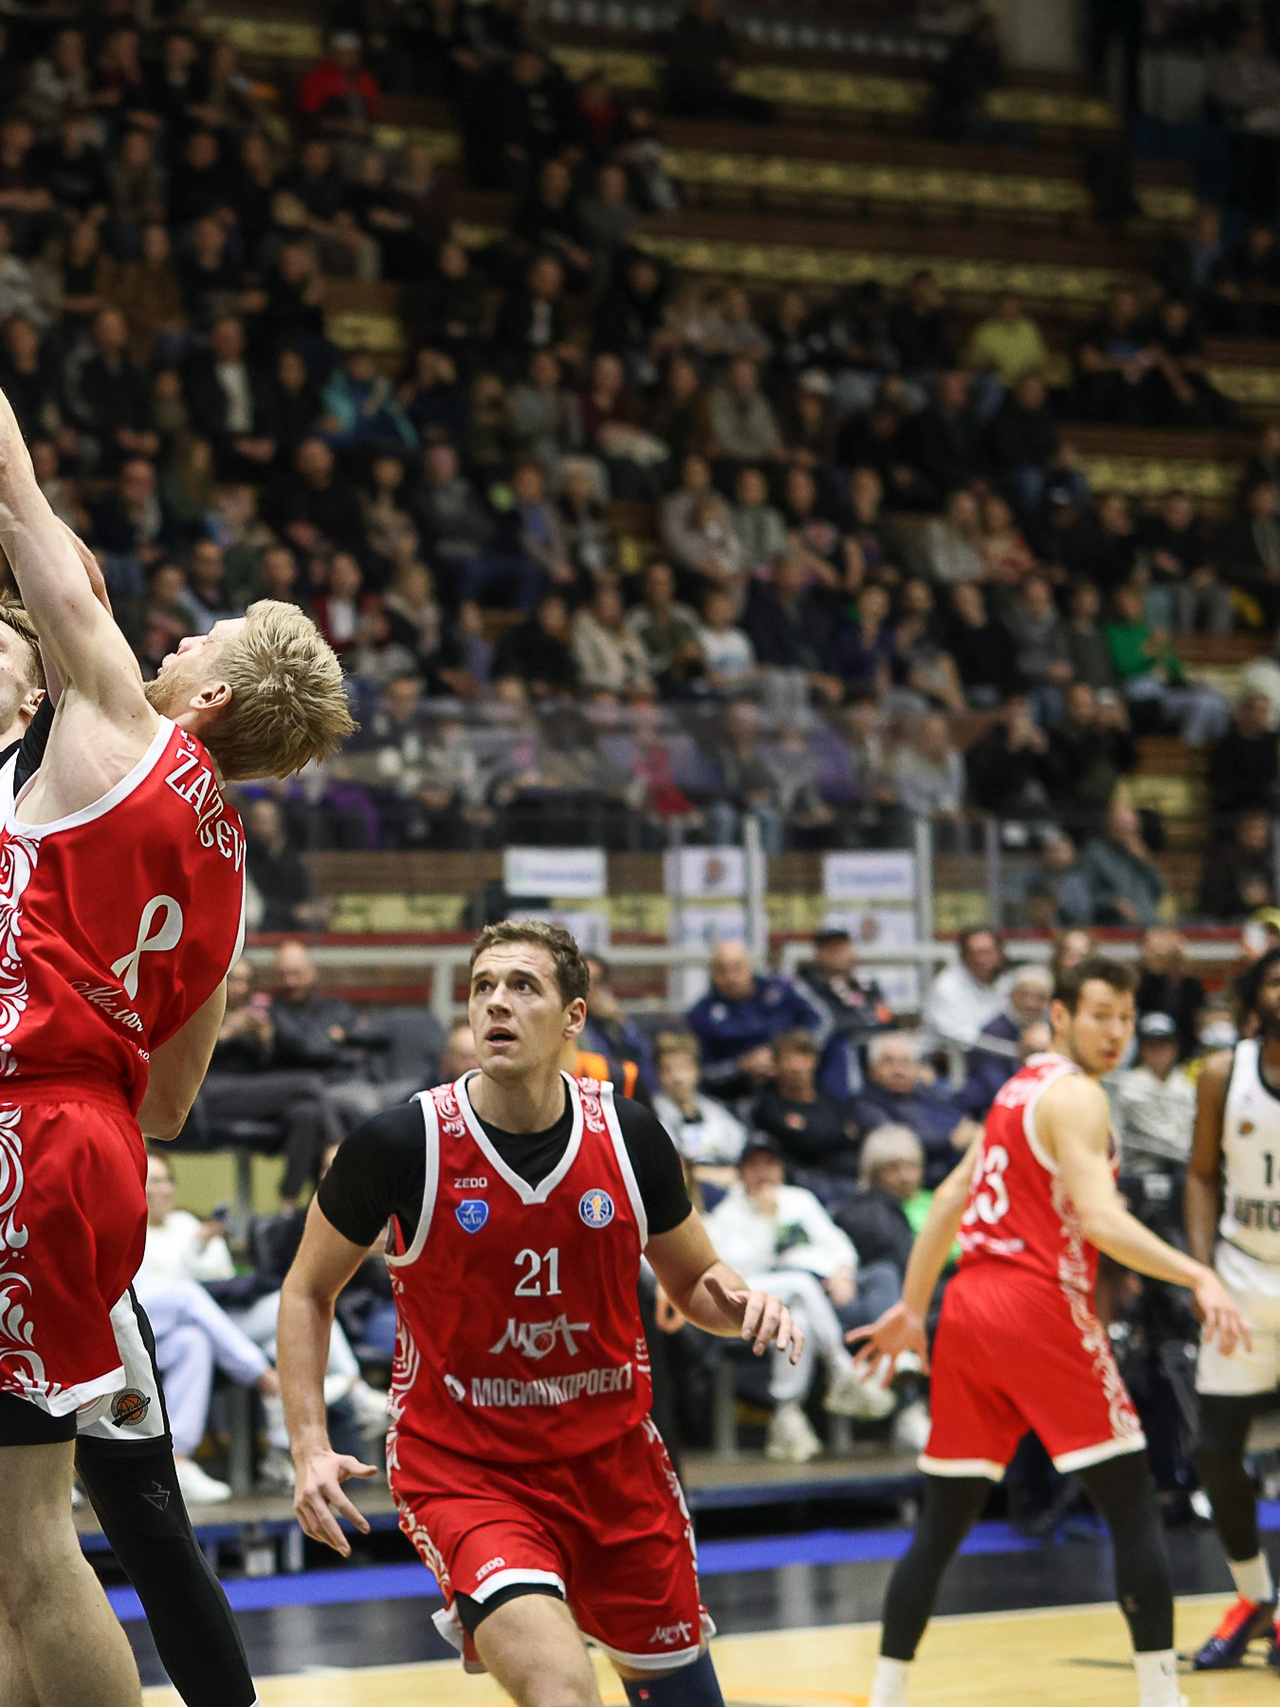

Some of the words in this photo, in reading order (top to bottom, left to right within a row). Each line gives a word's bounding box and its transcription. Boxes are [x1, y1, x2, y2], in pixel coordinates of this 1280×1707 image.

[454, 1177, 488, 1189] ZEDO
[514, 1247, 562, 1297] 21
[471, 1361, 632, 1407] МОСИНЖПРОЕКТ
[475, 1556, 506, 1581] ZEDO
